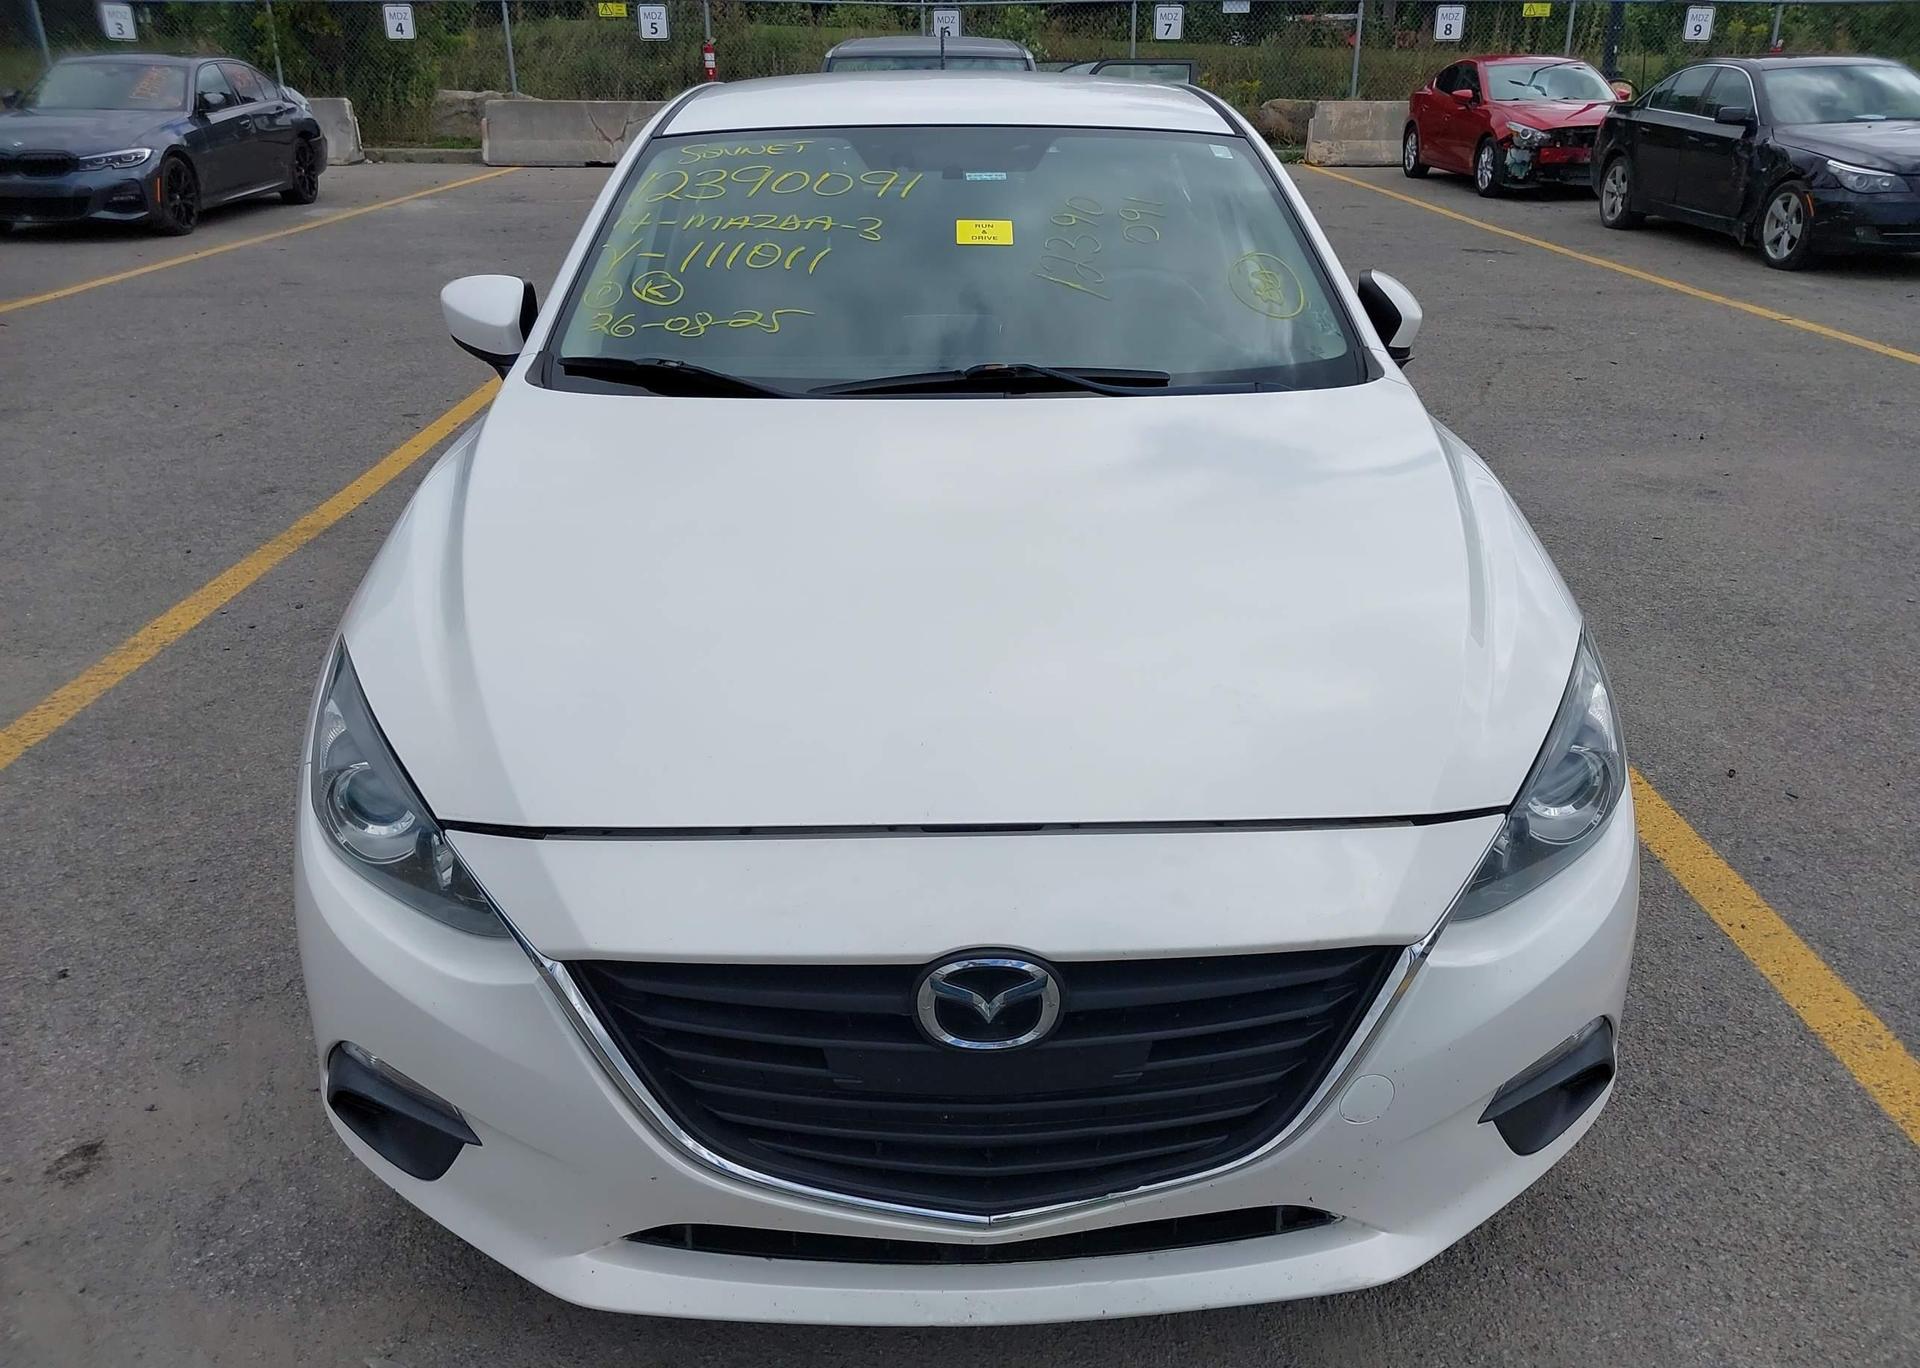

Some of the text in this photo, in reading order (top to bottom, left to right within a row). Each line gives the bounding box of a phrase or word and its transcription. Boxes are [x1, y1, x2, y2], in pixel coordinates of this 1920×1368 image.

[389, 11, 409, 21] MDZ
[643, 11, 663, 20] MDZ
[937, 15, 956, 24] MDZ
[1159, 12, 1179, 21] MDZ
[1441, 12, 1460, 21] MDZ
[1690, 13, 1710, 22] MDZ
[115, 22, 125, 36] 3
[395, 22, 405, 35] 4
[650, 22, 659, 35] 5
[1164, 23, 1173, 36] 7
[1443, 23, 1453, 36] 8
[1693, 23, 1703, 37] 9
[587, 308, 817, 338] 26-08-25
